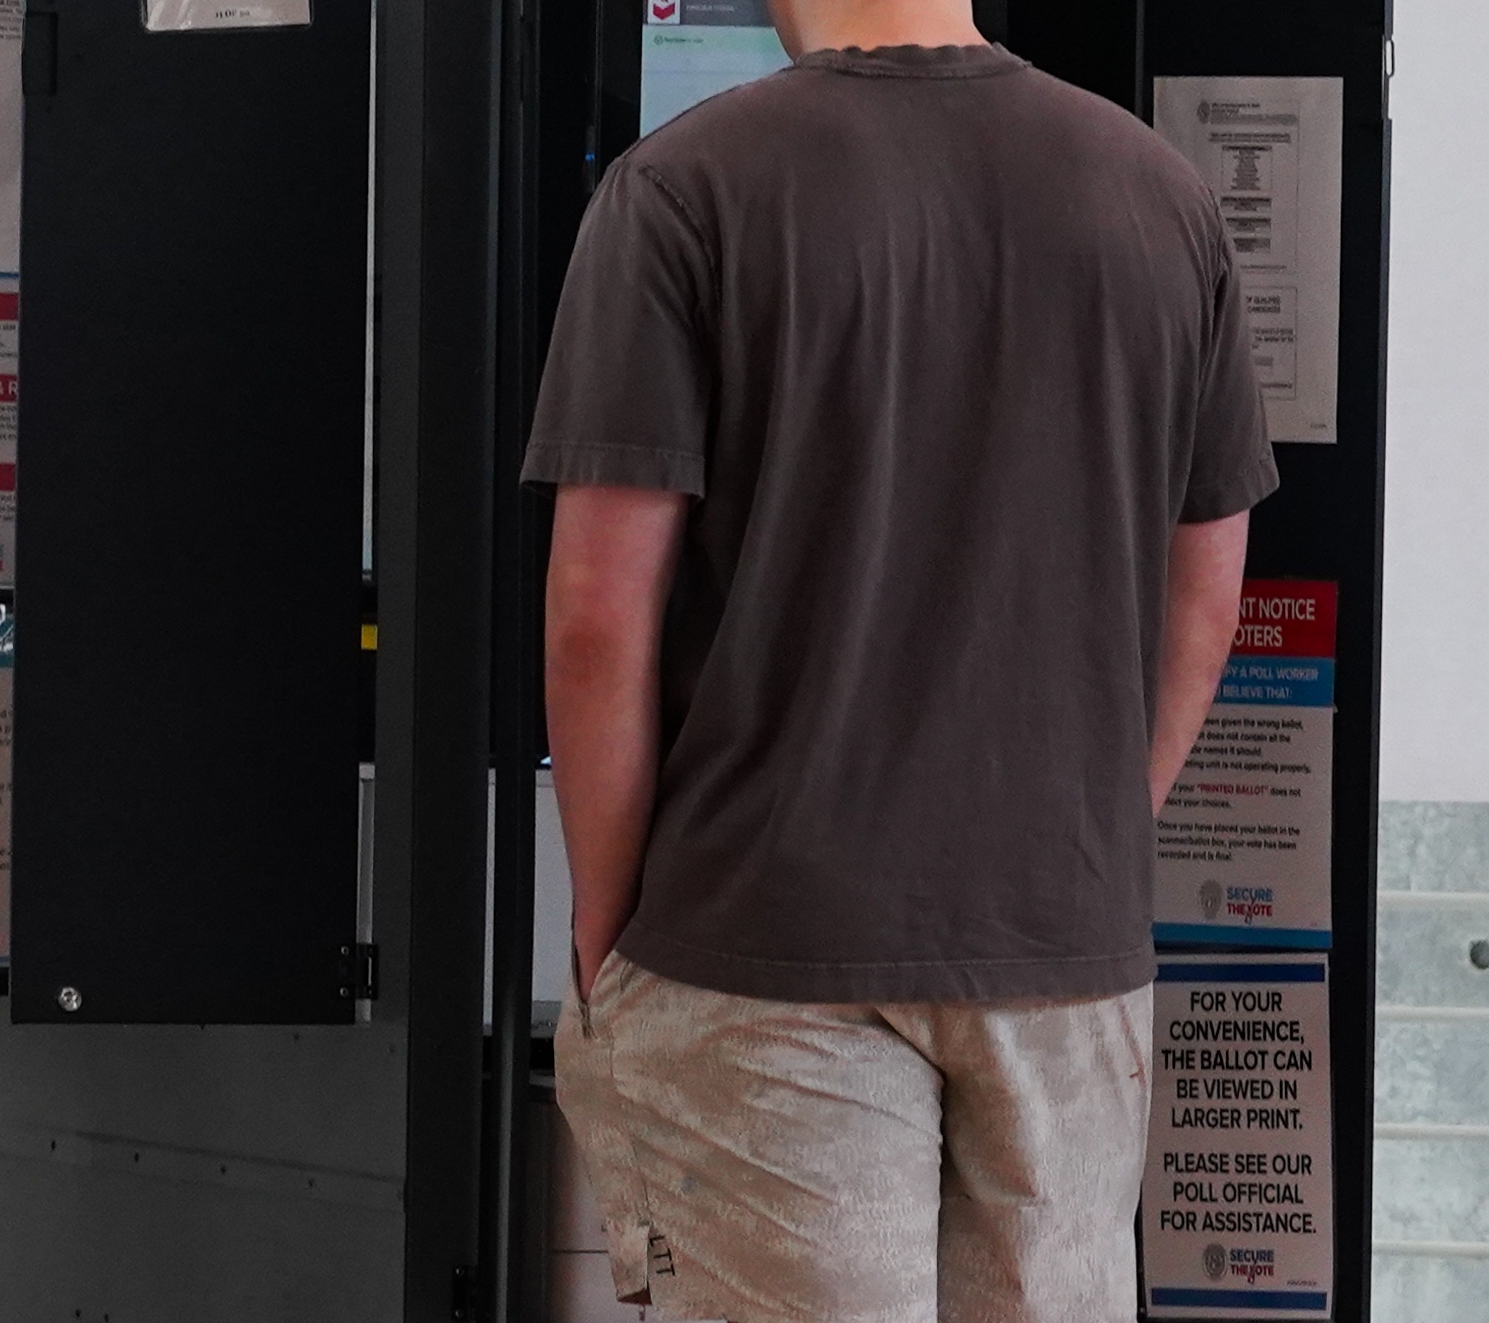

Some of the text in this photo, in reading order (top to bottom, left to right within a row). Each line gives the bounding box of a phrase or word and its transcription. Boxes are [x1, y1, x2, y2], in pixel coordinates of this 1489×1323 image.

[1258, 597, 1316, 621] NOTICE
[1232, 624, 1283, 647] OTERS
[1240, 667, 1248, 678] A
[1249, 666, 1272, 679] POLL
[1276, 668, 1319, 681] WORKER
[1223, 684, 1264, 698] BELIEVE
[1227, 886, 1273, 902] SECURE
[1227, 902, 1246, 916] THE
[1190, 990, 1282, 1012] FOR YOUR
[1169, 1019, 1305, 1045] CONVENIENCE,
[1161, 1049, 1312, 1072] THE BALLOT CAN
[1176, 1078, 1297, 1101] BE VIEWED IN
[1170, 1107, 1303, 1130] LARGER PRINT.
[1163, 1152, 1312, 1175] PLEASE SEE OUR
[1172, 1181, 1303, 1205] POLL OFFICIAL
[1160, 1210, 1317, 1234] FOR ASSISTANCE.
[1230, 1248, 1275, 1263] SECURE
[1230, 1264, 1250, 1276] THE
